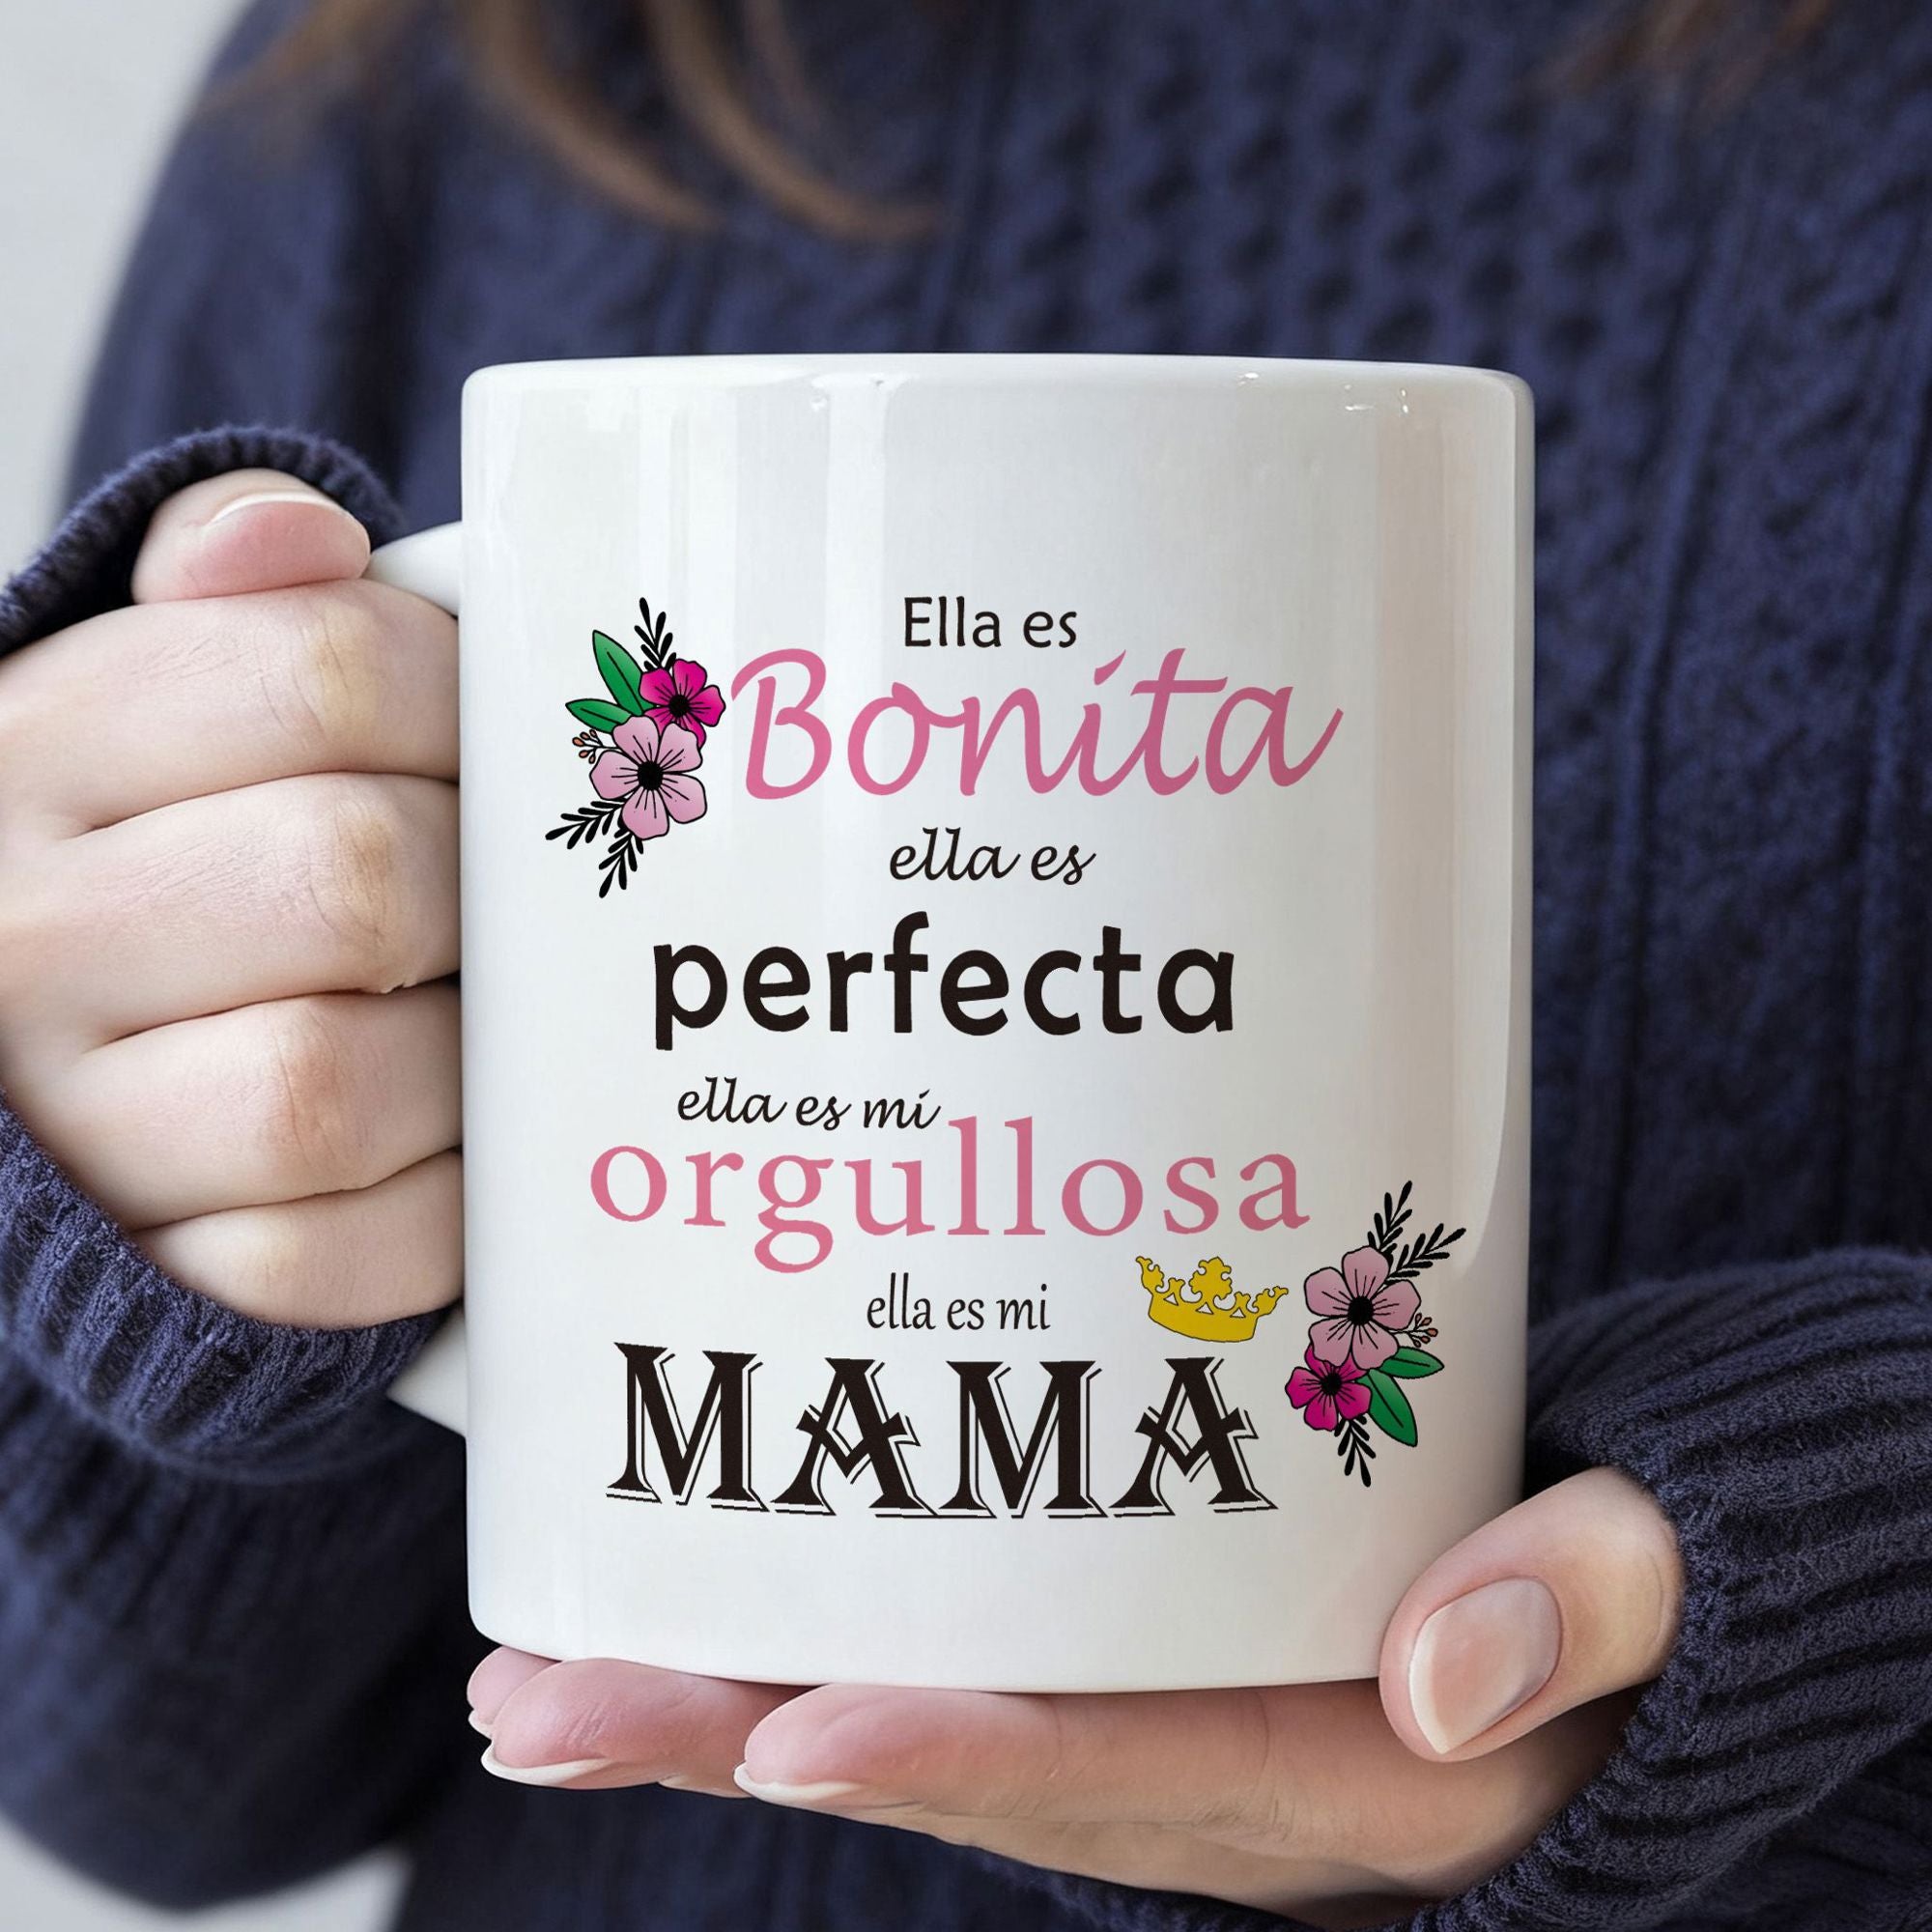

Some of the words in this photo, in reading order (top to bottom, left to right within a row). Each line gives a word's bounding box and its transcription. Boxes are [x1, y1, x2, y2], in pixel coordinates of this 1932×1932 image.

[904, 595, 1002, 649] Ella
[1022, 611, 1078, 649] es
[730, 648, 1345, 800] Bonita
[889, 826, 1022, 881] ella
[1030, 844, 1097, 886] es
[653, 910, 1236, 1052] perfecta
[677, 1076, 788, 1124] ella
[795, 1095, 852, 1131] es
[590, 1116, 1311, 1273] orgullosa
[867, 1271, 937, 1330] ella
[947, 1298, 985, 1331] es
[995, 1283, 1051, 1331] mi
[605, 1342, 1280, 1520] MAMA
